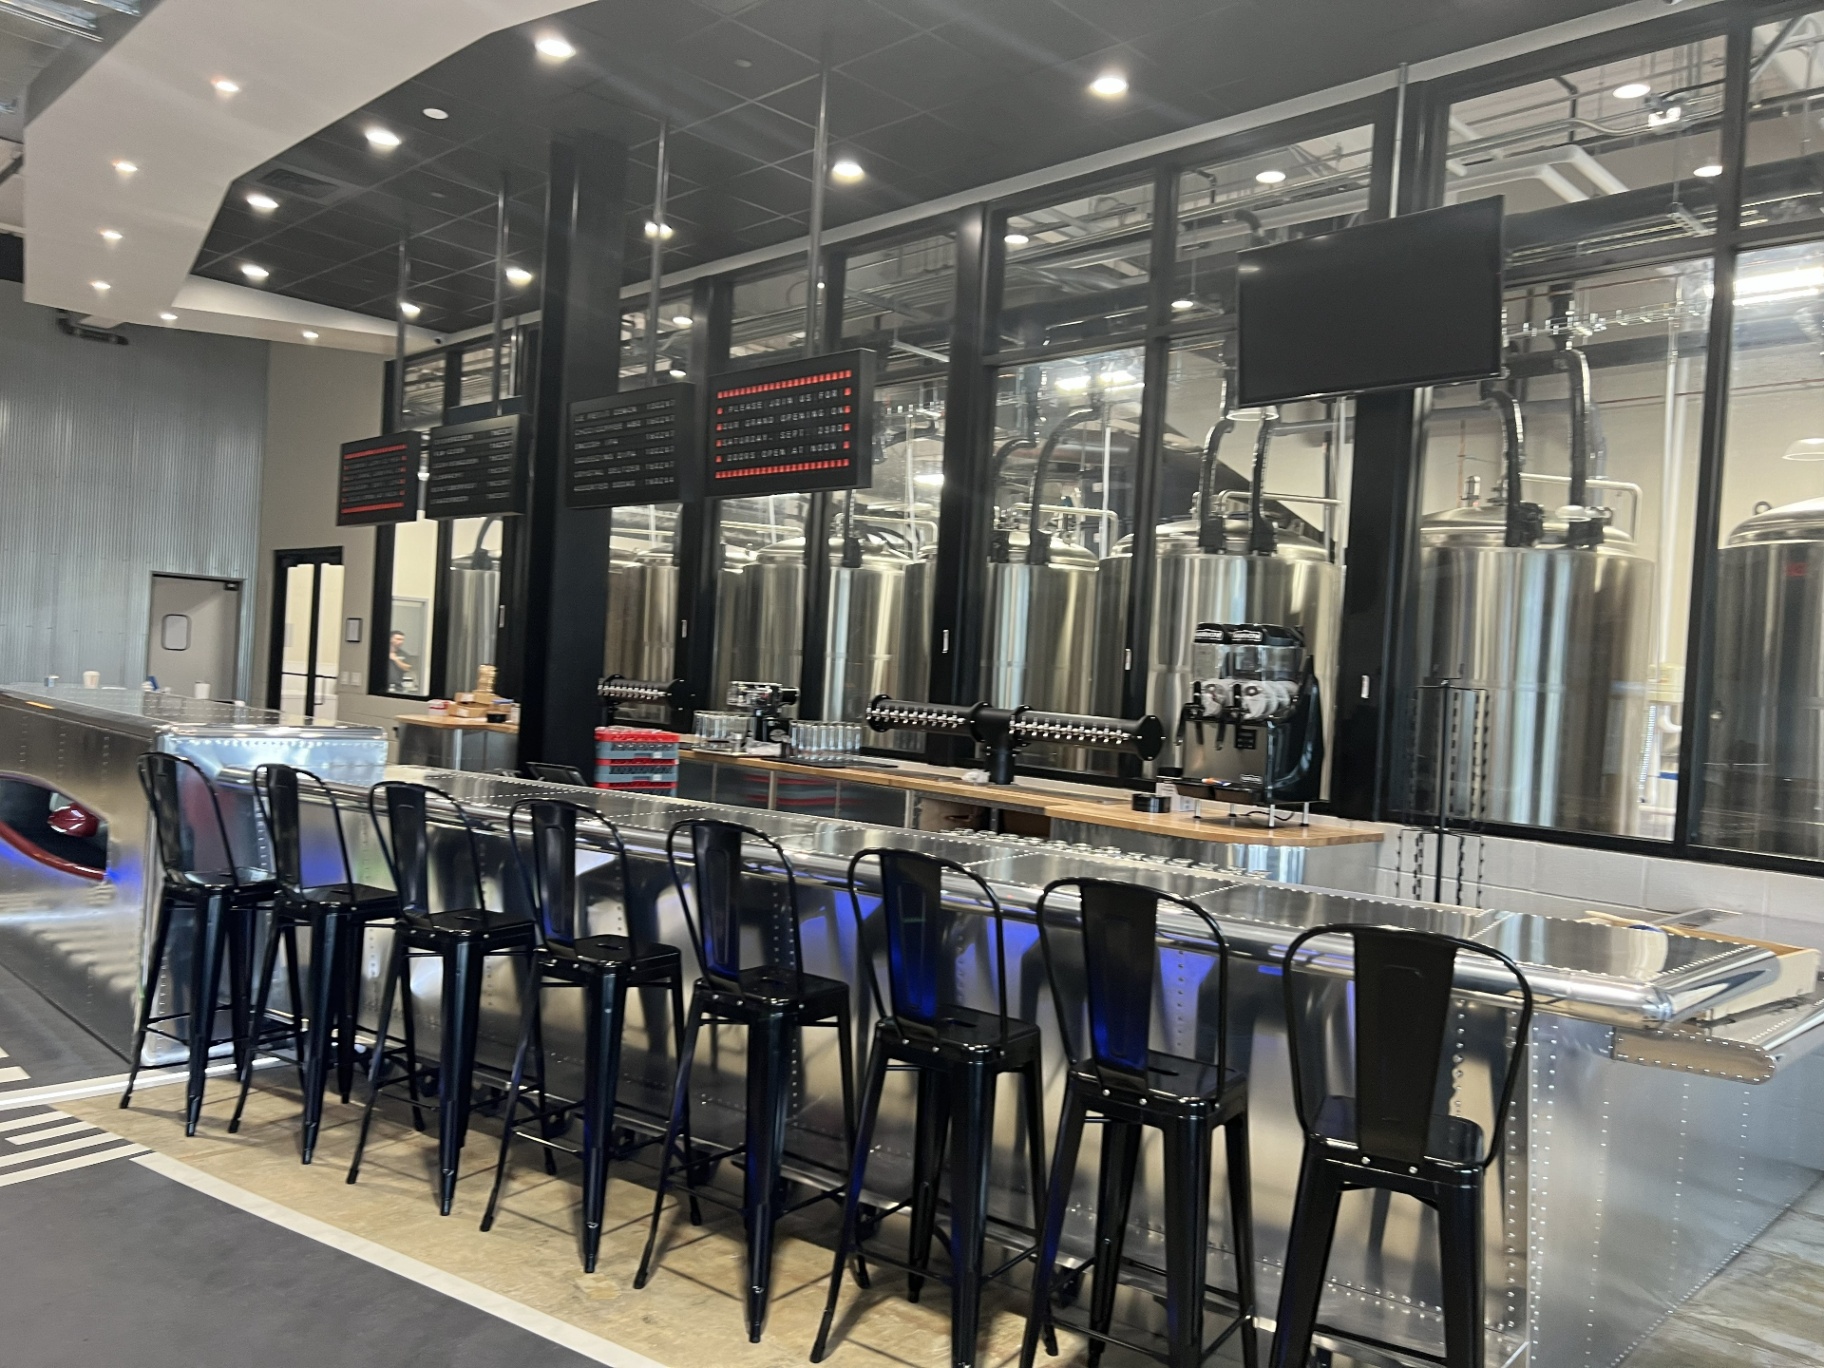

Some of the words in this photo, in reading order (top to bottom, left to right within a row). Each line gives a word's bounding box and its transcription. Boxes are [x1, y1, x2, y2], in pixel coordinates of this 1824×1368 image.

[729, 401, 762, 413] PLEASE
[769, 397, 793, 407] JOIN
[799, 394, 812, 403] US
[819, 390, 837, 399] FOR
[745, 416, 774, 427] GRAND
[781, 409, 824, 422] OPENING
[762, 449, 785, 458] OPEN
[792, 445, 803, 454] AT
[811, 443, 836, 452] NOON
